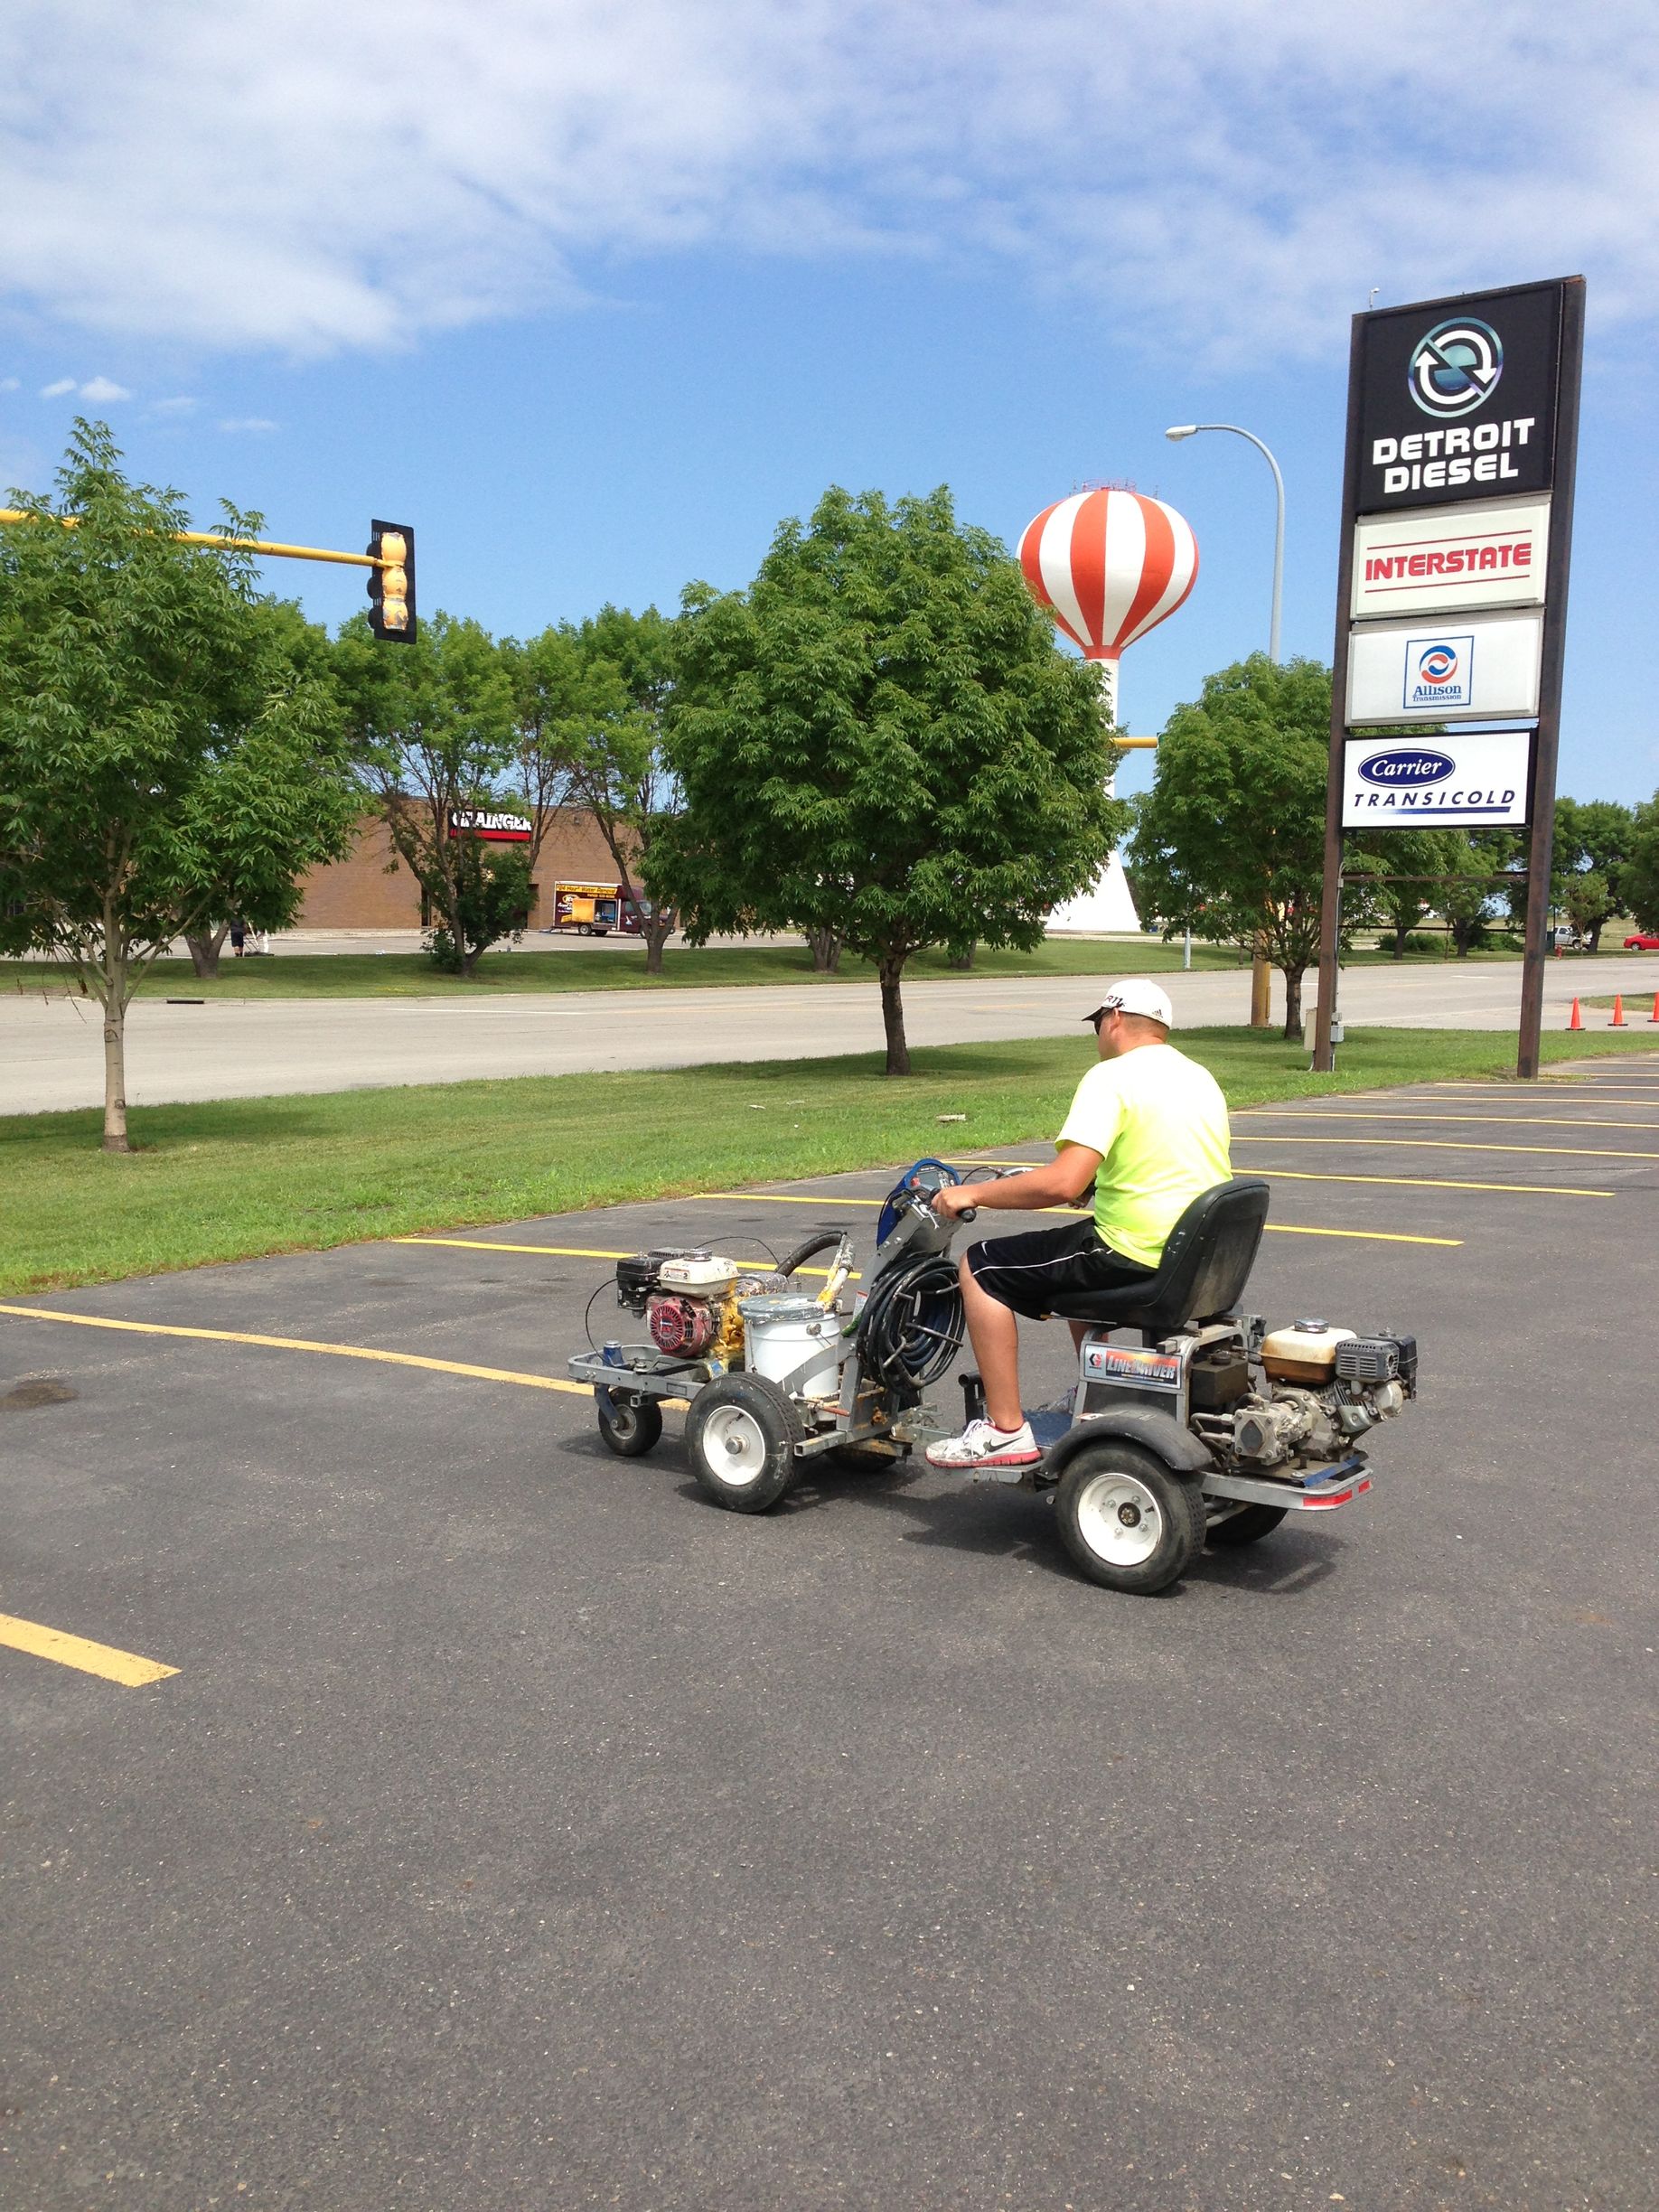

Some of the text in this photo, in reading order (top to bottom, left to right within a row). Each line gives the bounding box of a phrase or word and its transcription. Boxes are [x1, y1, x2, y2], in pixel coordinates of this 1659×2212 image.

[1373, 417, 1535, 464] DETROIT
[1383, 452, 1519, 493] DIESEL
[1364, 543, 1532, 581] INTERSTATE
[1412, 694, 1462, 702] Transmission
[1414, 685, 1462, 696] Allison
[1371, 758, 1443, 777] Carrier
[1354, 790, 1515, 807] TRANSICOLD
